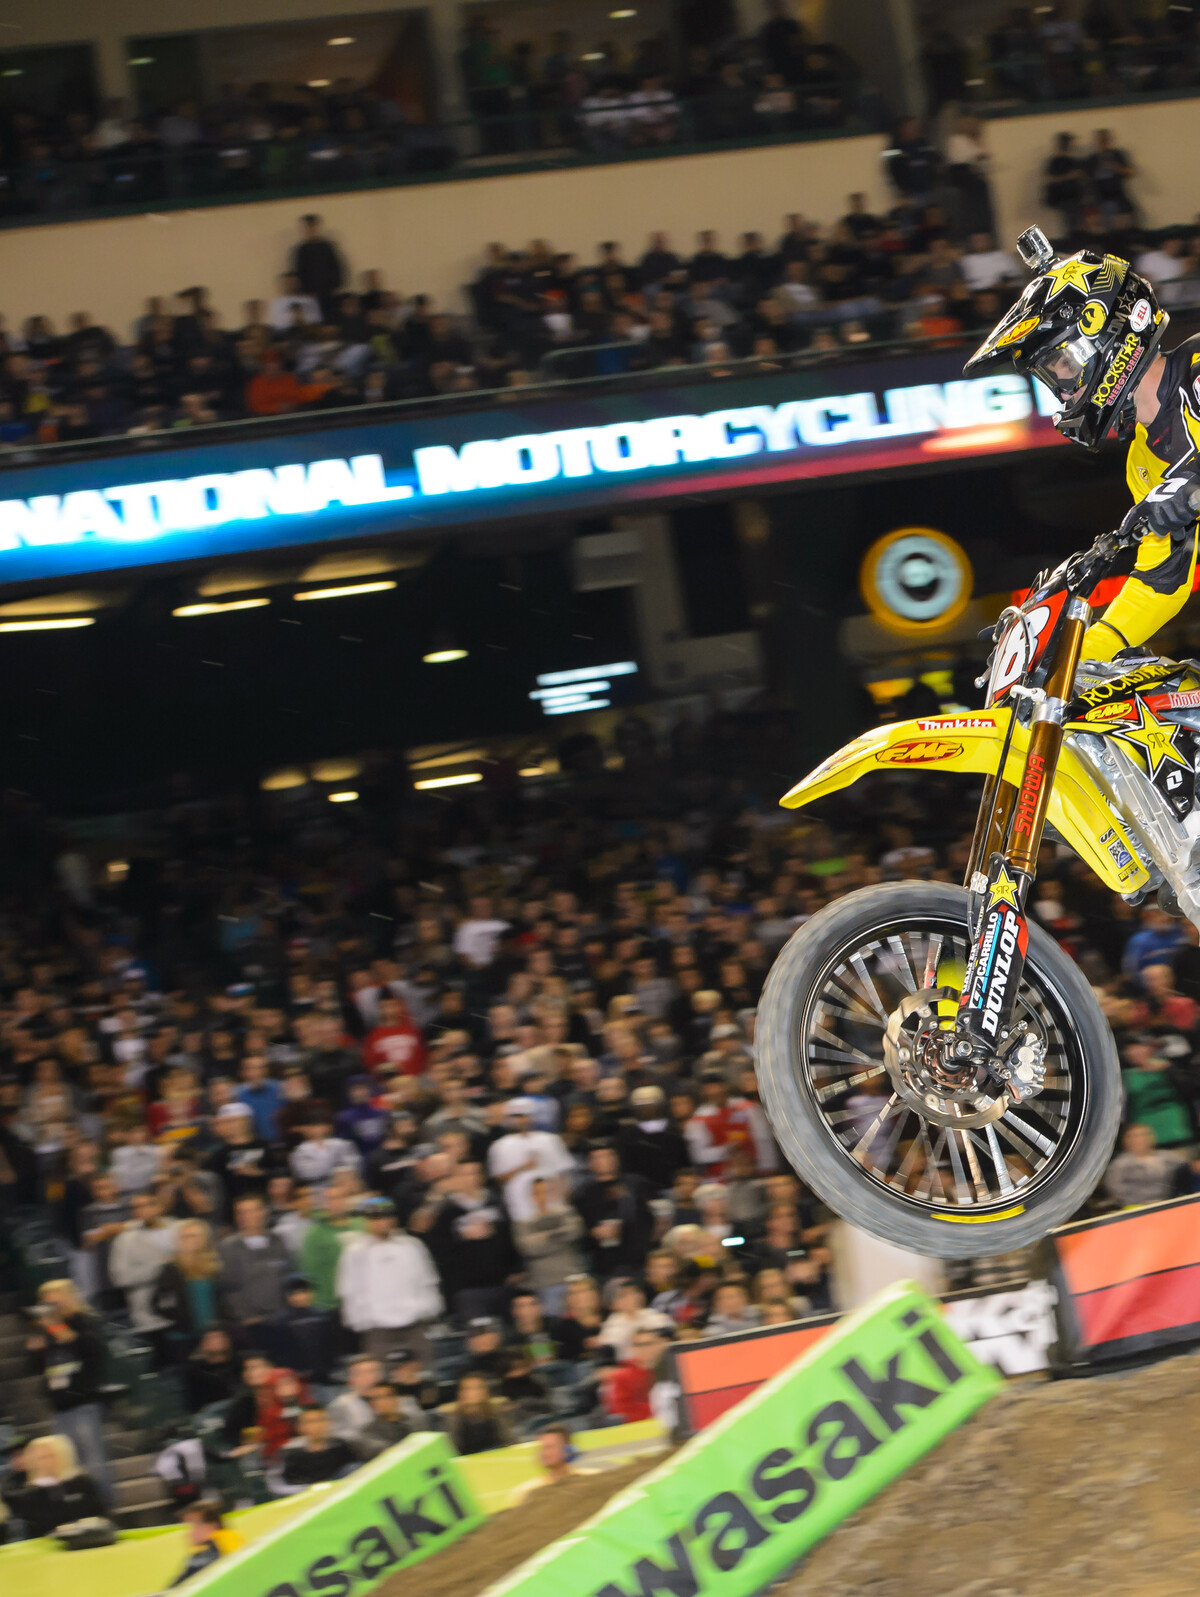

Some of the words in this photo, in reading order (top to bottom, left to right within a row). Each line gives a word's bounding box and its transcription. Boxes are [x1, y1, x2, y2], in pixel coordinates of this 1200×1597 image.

[1092, 333, 1140, 407] ROCKSTAR
[1105, 372, 1128, 405] ENERGY
[1125, 346, 1143, 372] DRINK
[414, 374, 1030, 496] MOTORCYCLING
[1079, 664, 1171, 707] ROCKSTAR
[1087, 703, 1131, 720] FMF
[877, 742, 963, 763] FMF
[1014, 753, 1046, 837] SHOWA
[976, 911, 999, 977] CARRILLO
[981, 910, 1020, 1037] DUNLOP
